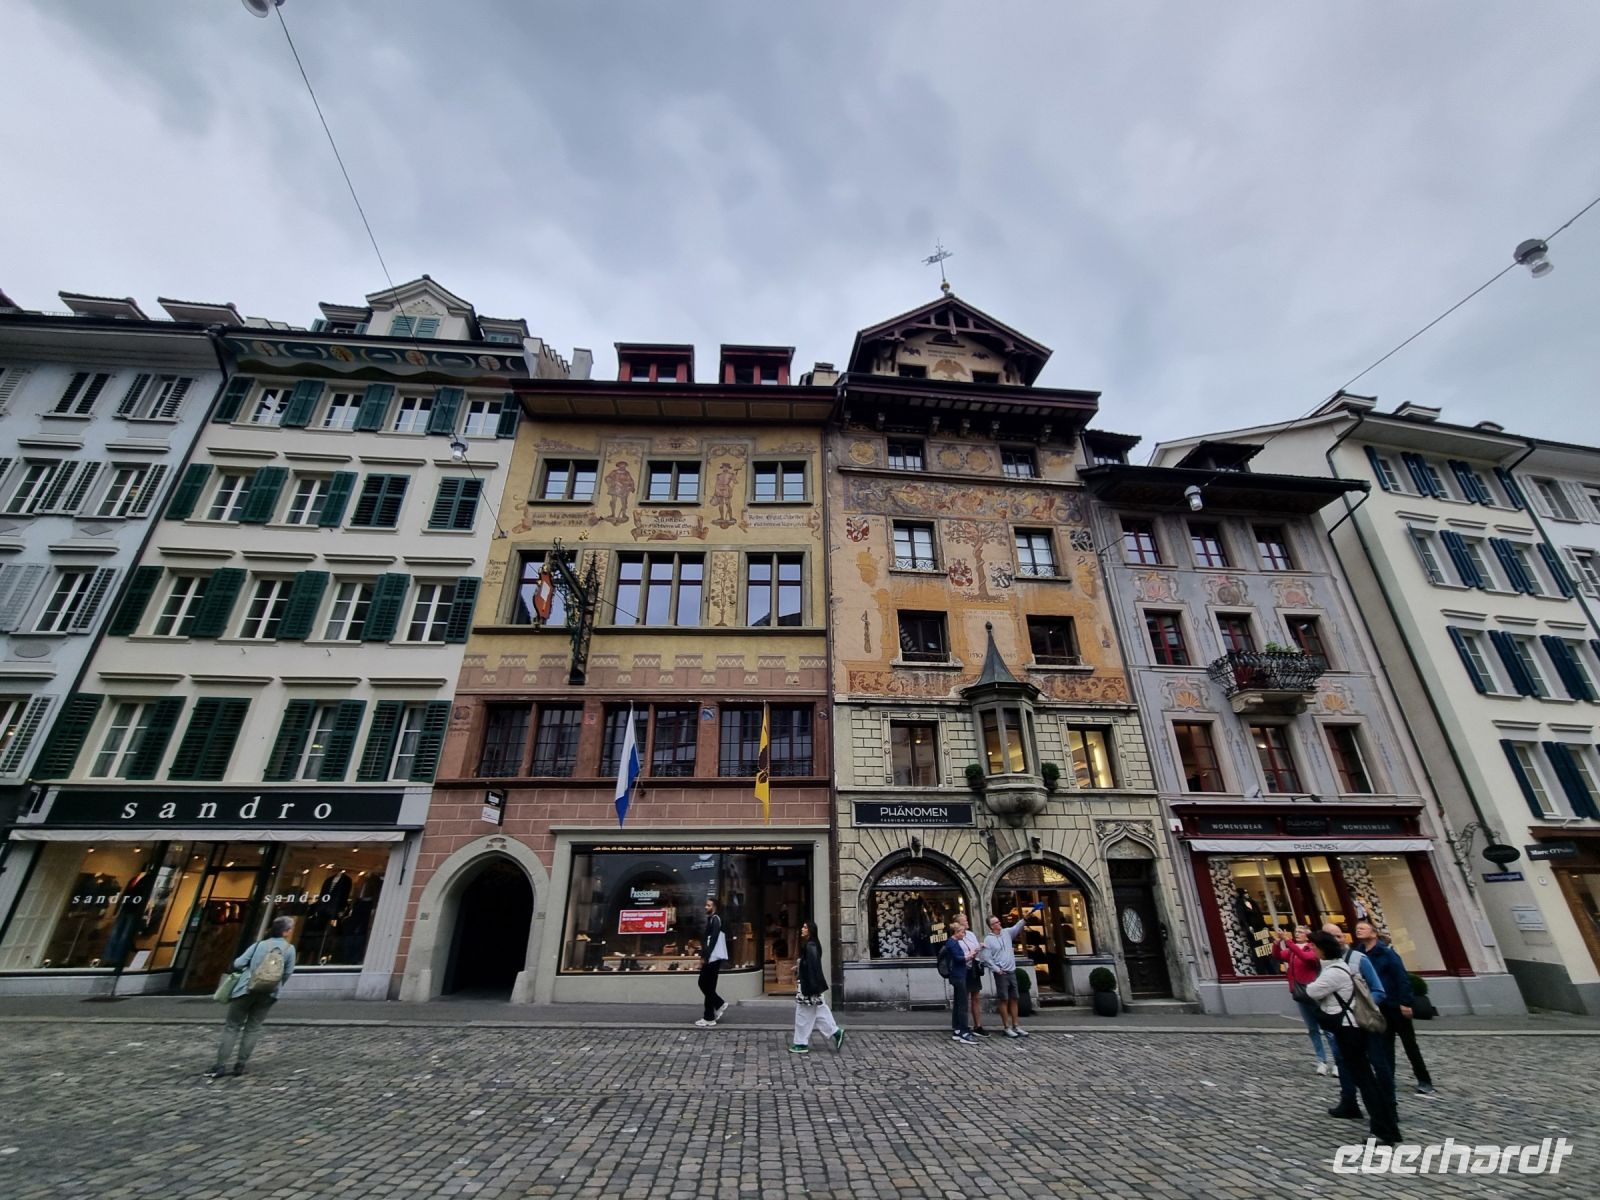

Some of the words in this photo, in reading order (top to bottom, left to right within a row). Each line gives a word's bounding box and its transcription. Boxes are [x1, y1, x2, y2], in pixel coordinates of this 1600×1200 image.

[121, 796, 333, 820] sandro
[880, 805, 948, 817] PHÄNOMEN
[72, 892, 143, 904] sandro
[263, 891, 331, 904] sandro
